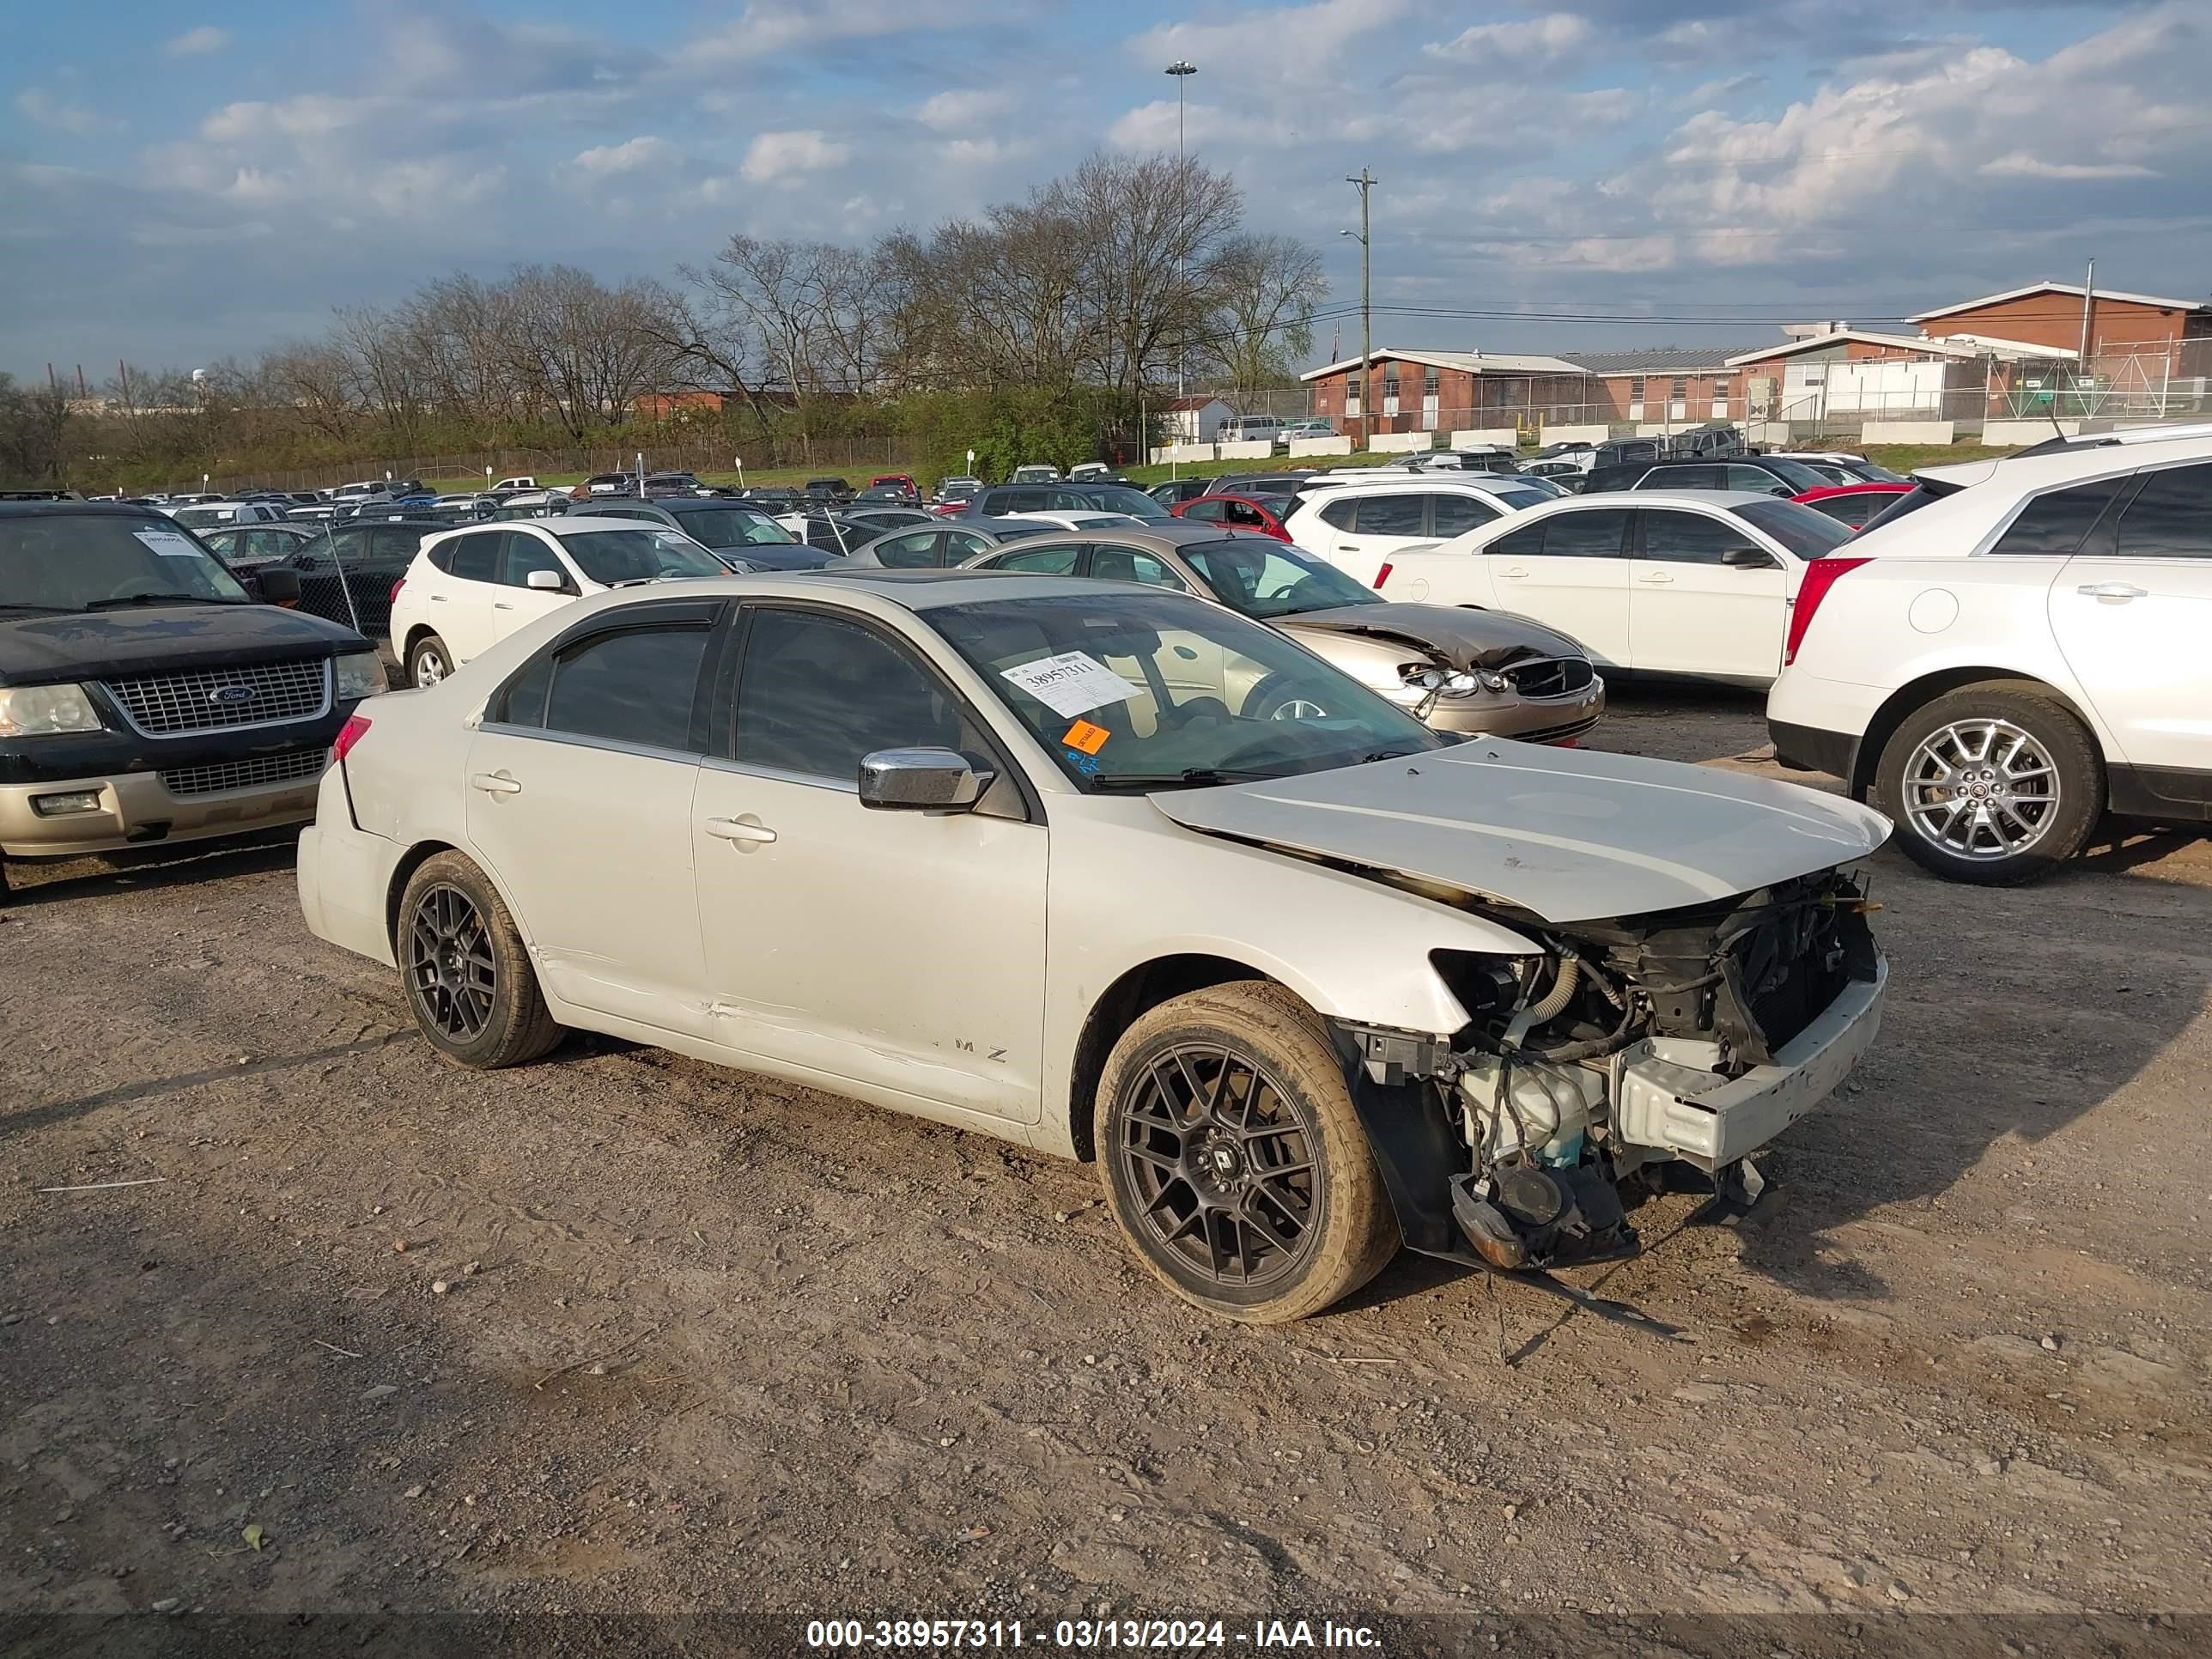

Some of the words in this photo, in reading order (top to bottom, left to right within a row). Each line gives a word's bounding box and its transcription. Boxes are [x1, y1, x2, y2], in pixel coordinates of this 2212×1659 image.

[1026, 662, 1094, 688] 38957311
[224, 690, 246, 700] Ford
[1077, 727, 1096, 747] DETAILED
